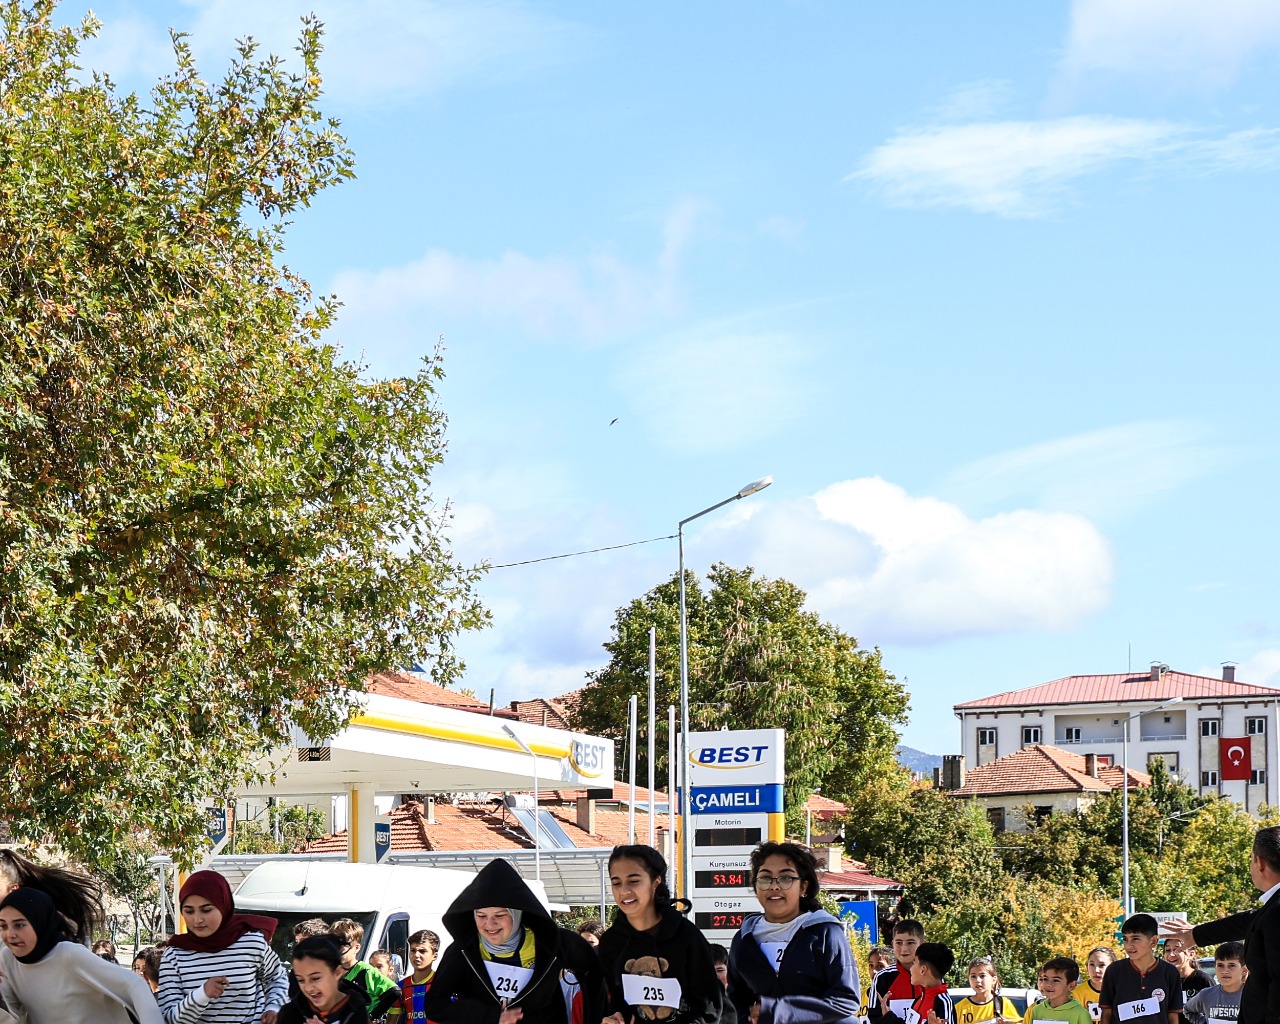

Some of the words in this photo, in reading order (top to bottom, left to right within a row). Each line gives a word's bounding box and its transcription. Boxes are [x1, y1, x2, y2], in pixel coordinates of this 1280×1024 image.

[577, 741, 606, 770] BEST
[698, 745, 769, 764] BEST
[695, 789, 760, 810] ÇAMELİ
[376, 831, 390, 842] BEST
[709, 861, 747, 869] Kurşunsuz
[713, 874, 742, 885] 53.84
[714, 900, 742, 909] Otogaz
[713, 914, 742, 927] 27.35
[496, 977, 519, 994] 234
[643, 986, 665, 1001] 235
[1131, 1003, 1146, 1015] 166
[962, 1013, 974, 1024] 10
